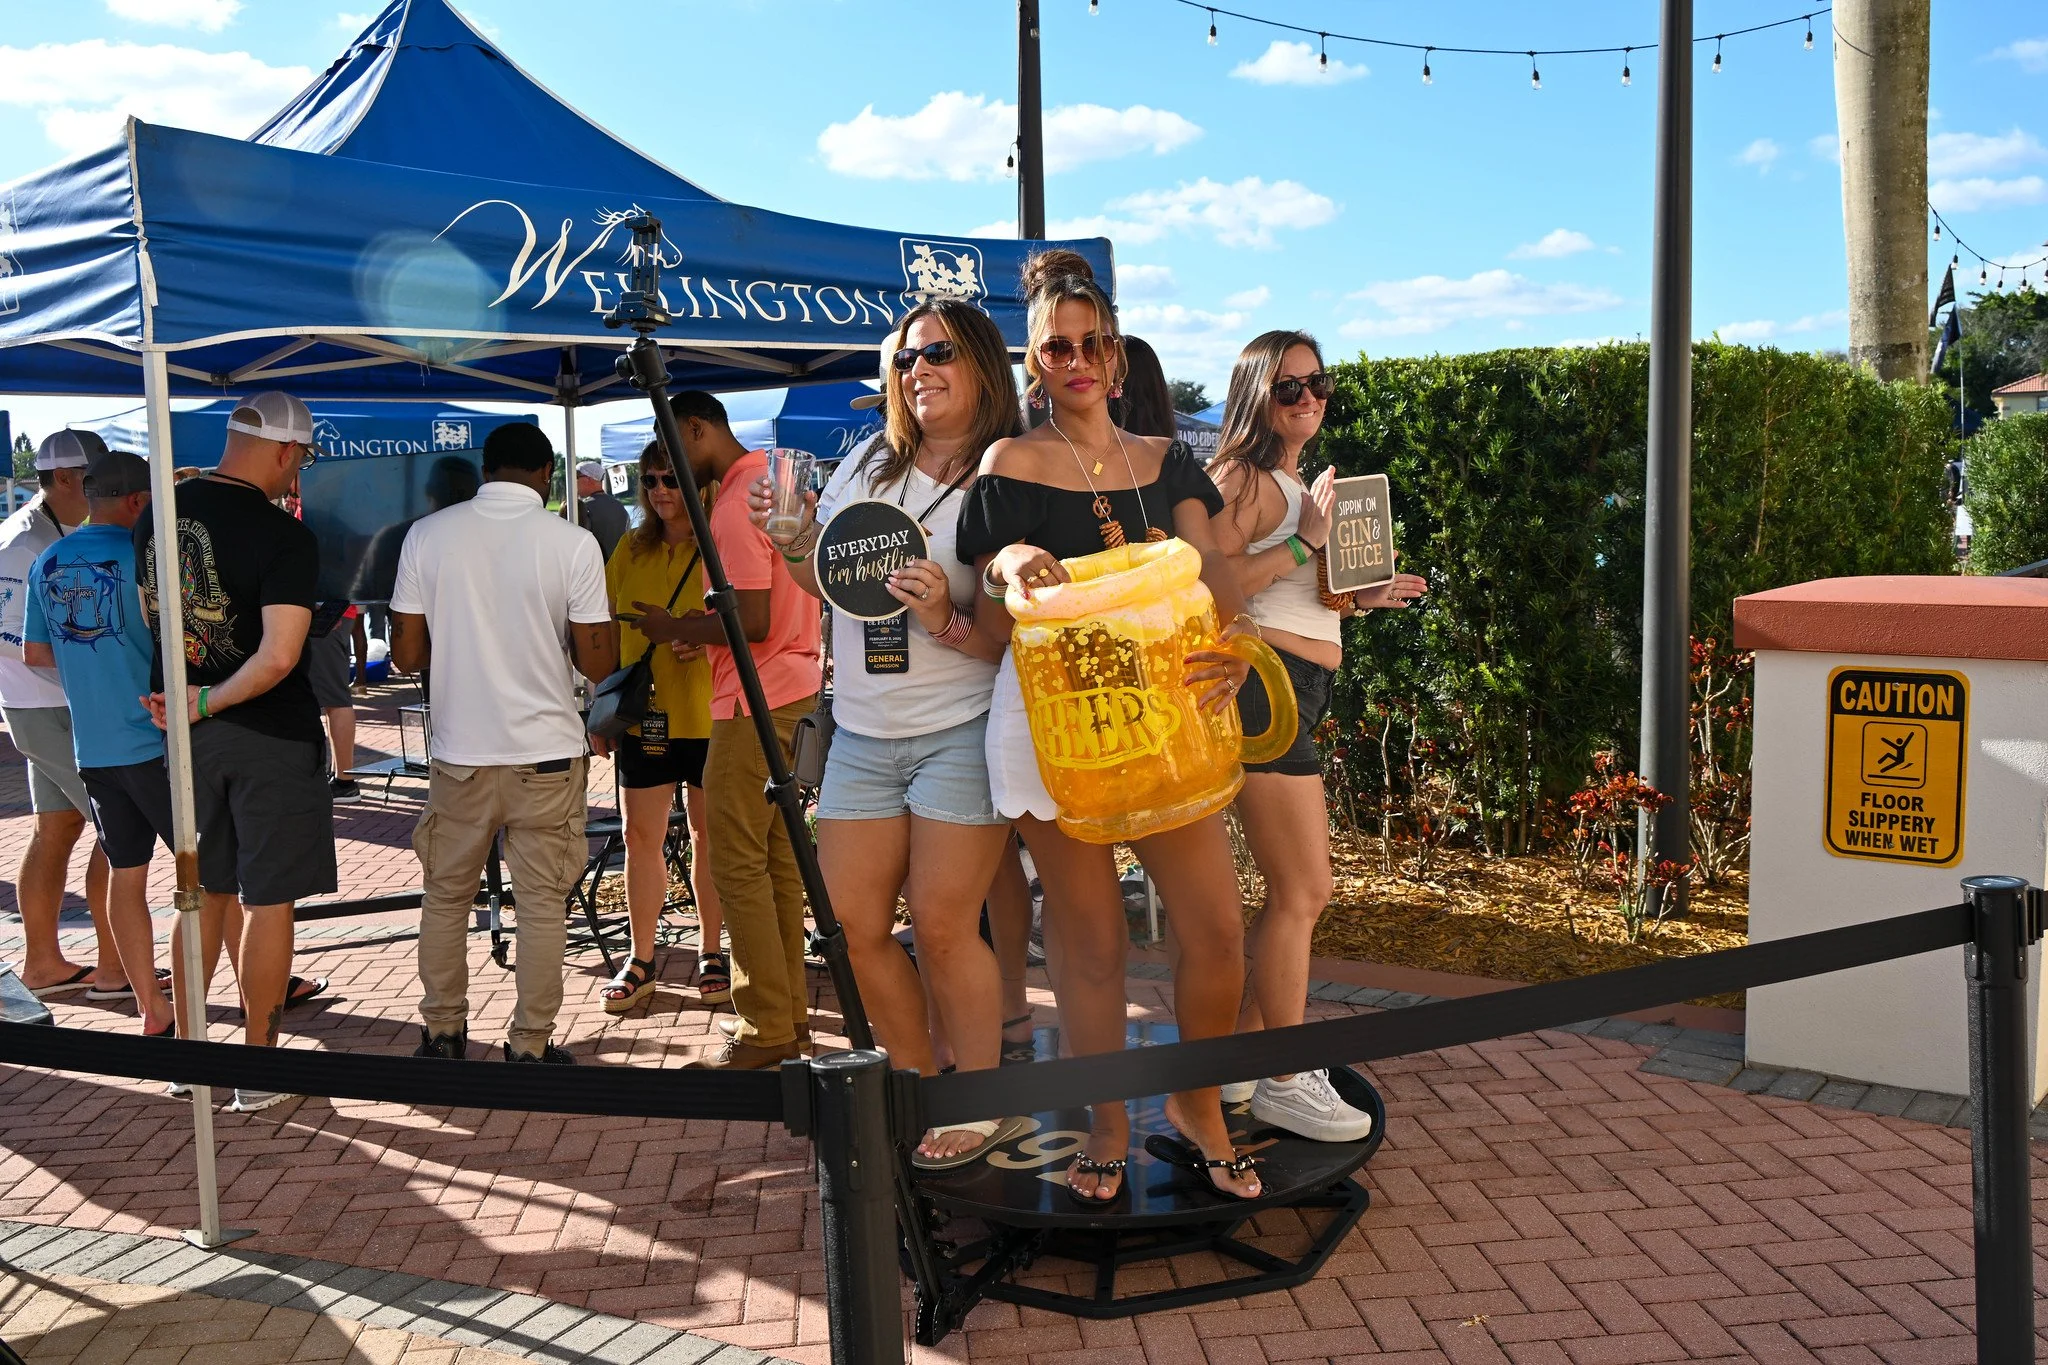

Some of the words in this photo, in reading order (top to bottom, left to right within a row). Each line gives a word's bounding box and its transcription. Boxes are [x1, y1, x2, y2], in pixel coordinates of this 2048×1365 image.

[613, 475, 625, 489] 39
[1338, 498, 1364, 516] SIPPIN'
[1365, 496, 1377, 512] ON
[826, 529, 910, 561] EVERYDAY
[1339, 543, 1384, 572] JUICE
[828, 563, 853, 585] i'm
[867, 654, 905, 663] GENERAL
[1840, 680, 1955, 716] CAUTION
[1861, 792, 1924, 812] FLOOR
[1848, 810, 1936, 834] SLIPPERY
[1845, 829, 1894, 849] WHEN
[1899, 834, 1939, 855] WET
